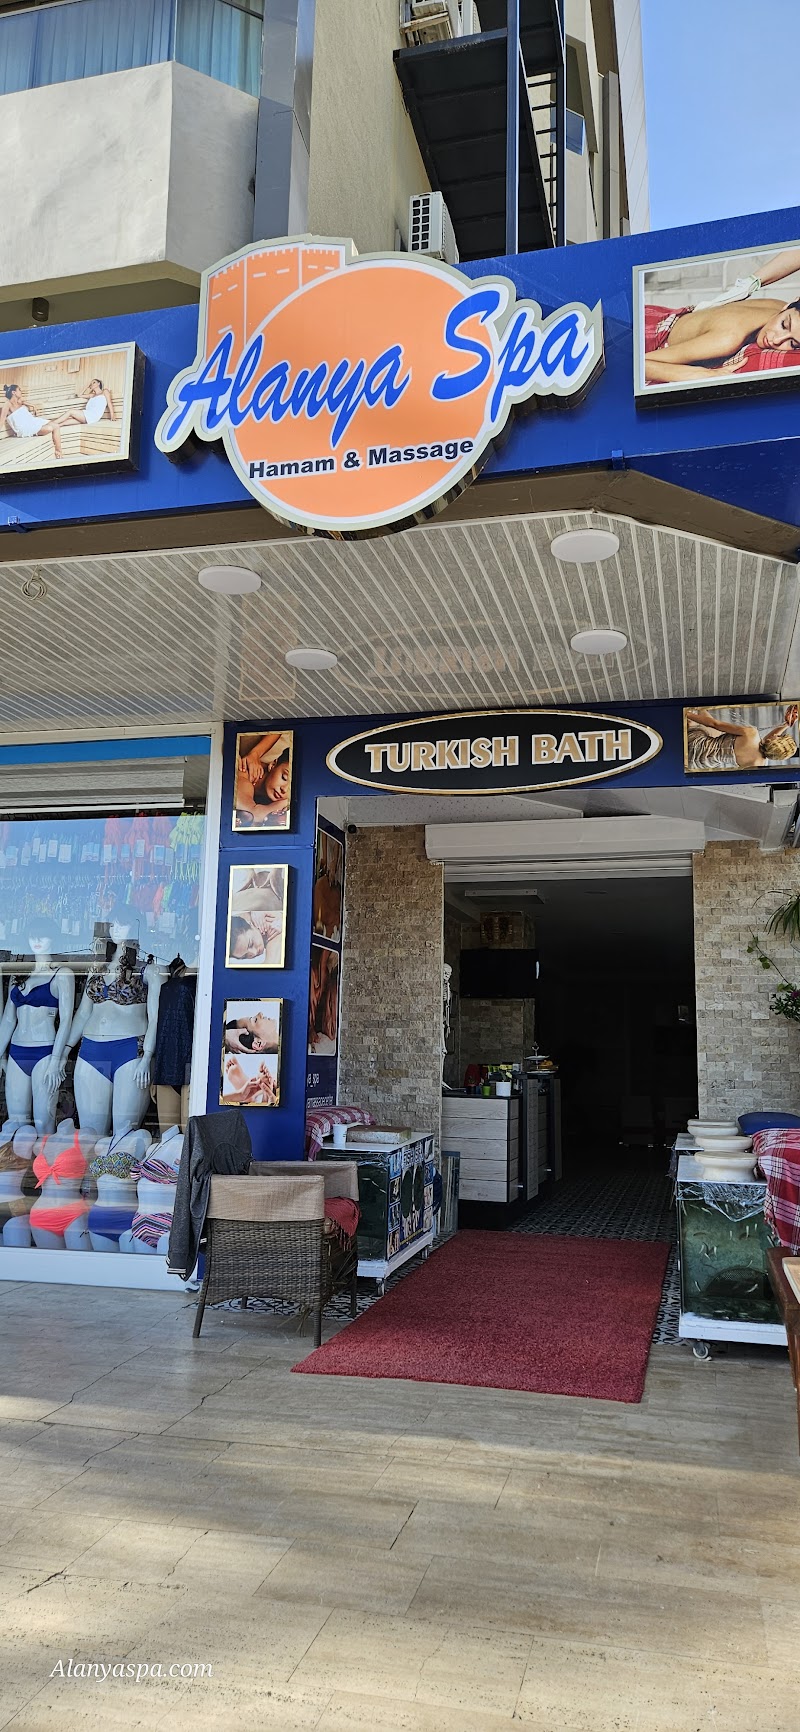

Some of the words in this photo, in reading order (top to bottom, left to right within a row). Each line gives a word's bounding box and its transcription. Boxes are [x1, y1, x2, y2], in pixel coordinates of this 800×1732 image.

[166, 331, 410, 448] Alanya
[431, 289, 590, 423] Spa
[249, 458, 335, 479] Hamam
[343, 451, 360, 469] &
[369, 439, 474, 466] Massage
[365, 735, 518, 773] TURKISH
[531, 728, 632, 764] BATH
